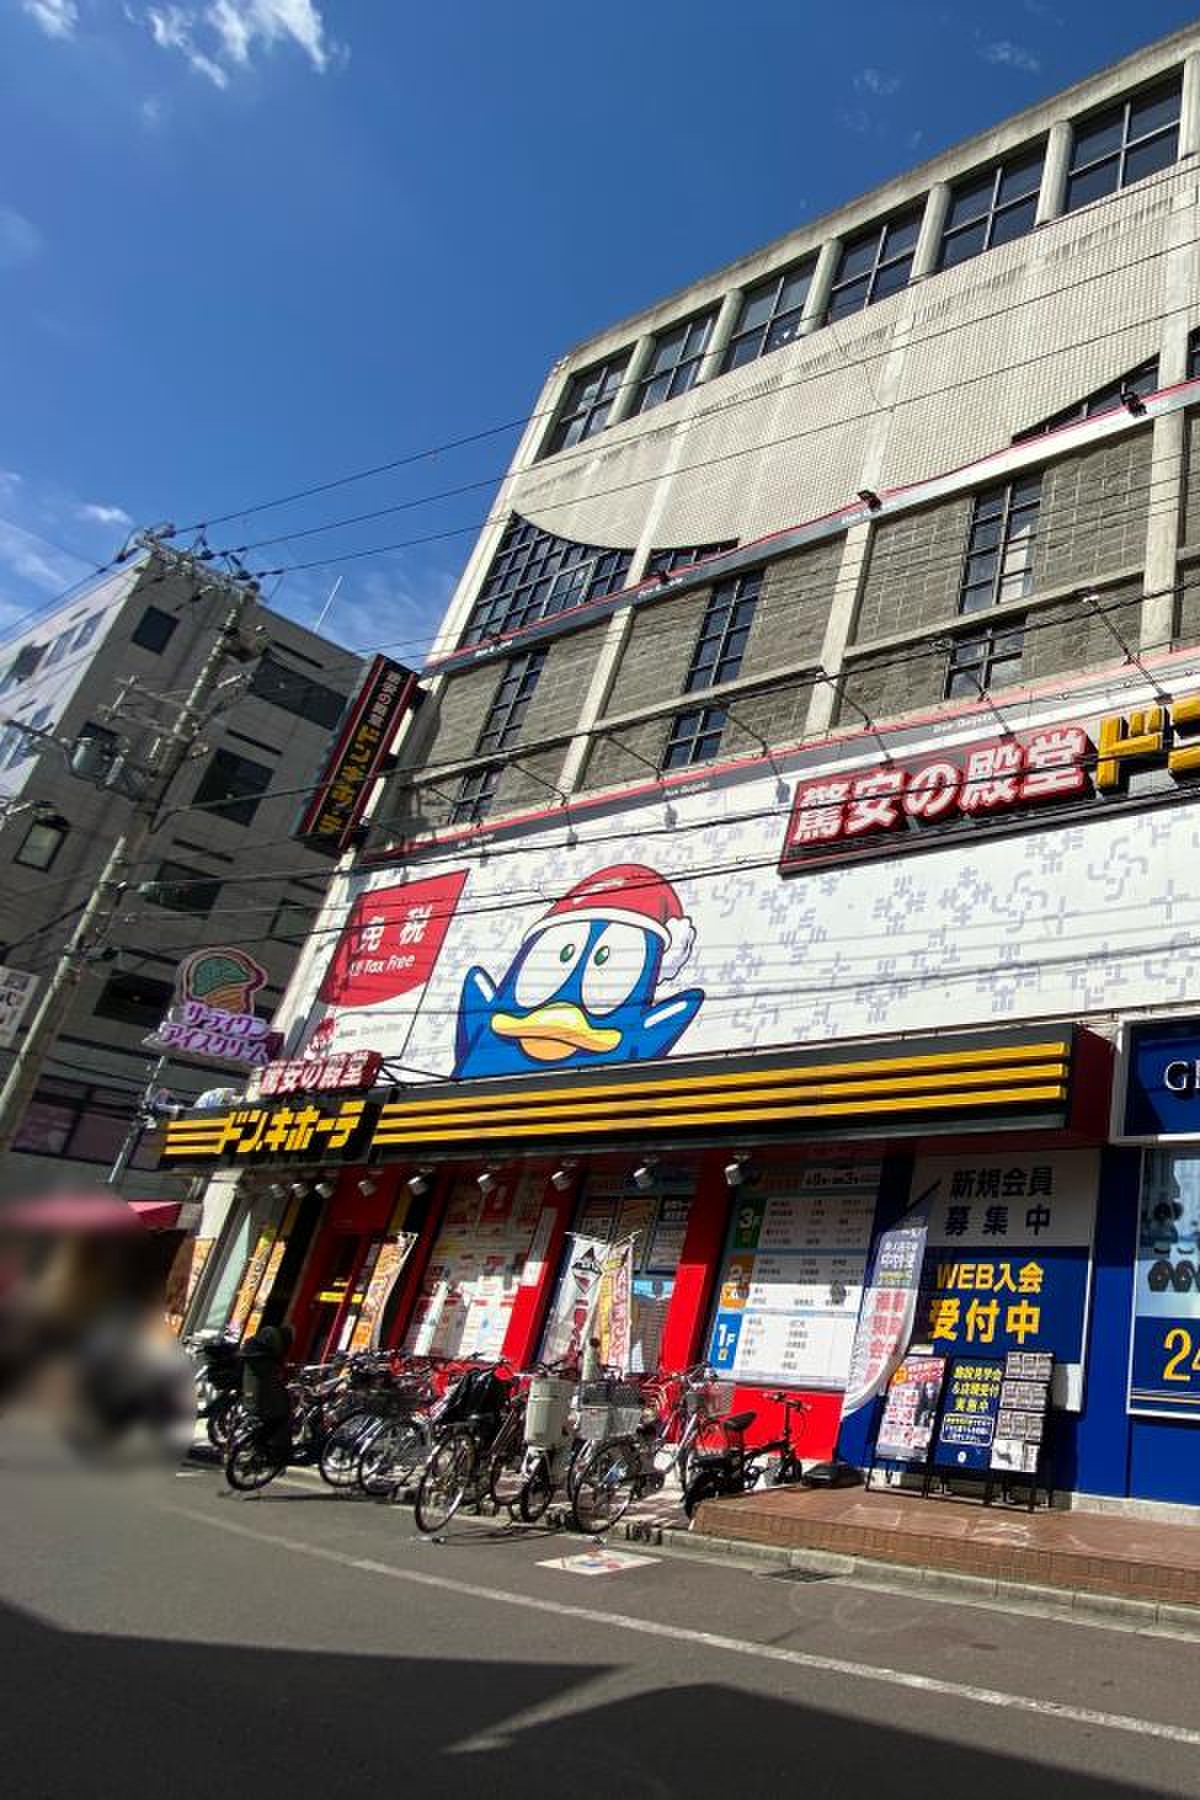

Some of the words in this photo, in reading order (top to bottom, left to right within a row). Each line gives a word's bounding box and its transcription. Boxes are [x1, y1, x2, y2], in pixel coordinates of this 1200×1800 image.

[794, 728, 1091, 841] 驚安の殿堂
[363, 958, 385, 974] Tax
[950, 1166, 1053, 1199] 新規会員
[944, 1204, 1051, 1236] 募集中
[936, 1261, 1045, 1294] WEB入会
[718, 1323, 736, 1347] 1F
[928, 1297, 1042, 1345] 受付中
